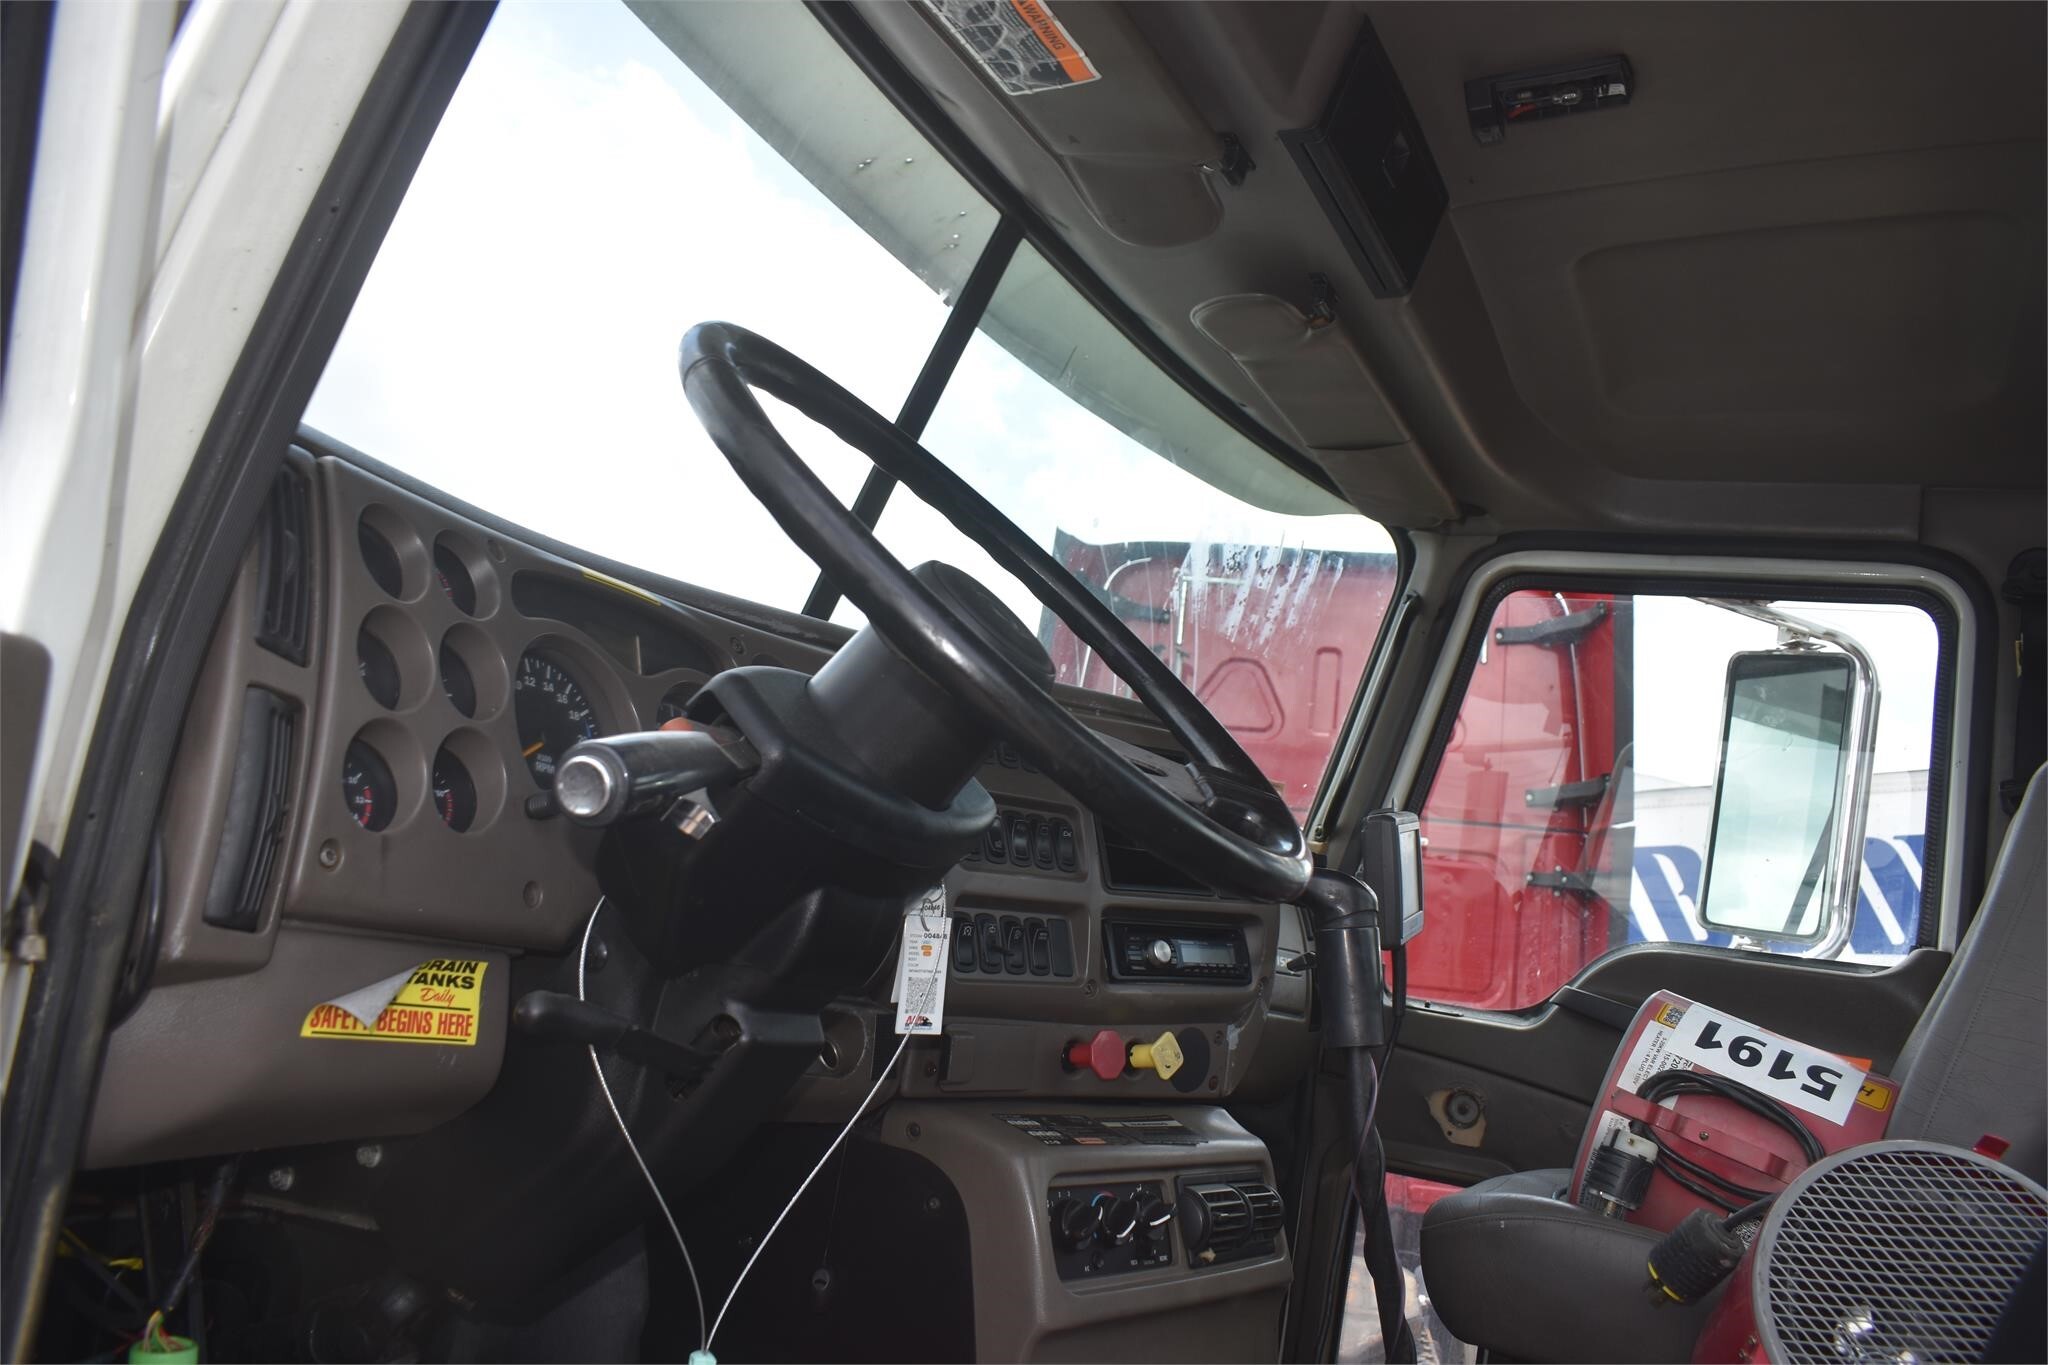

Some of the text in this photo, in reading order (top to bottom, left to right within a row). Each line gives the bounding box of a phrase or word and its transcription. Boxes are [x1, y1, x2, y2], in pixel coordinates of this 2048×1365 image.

[1021, 3, 1067, 50] WARNING
[406, 972, 475, 989] TANKS
[420, 987, 456, 1007] Daily
[376, 1008, 433, 1035] BEGINS
[436, 1014, 474, 1037] HERE
[1694, 1020, 1844, 1102] 5191
